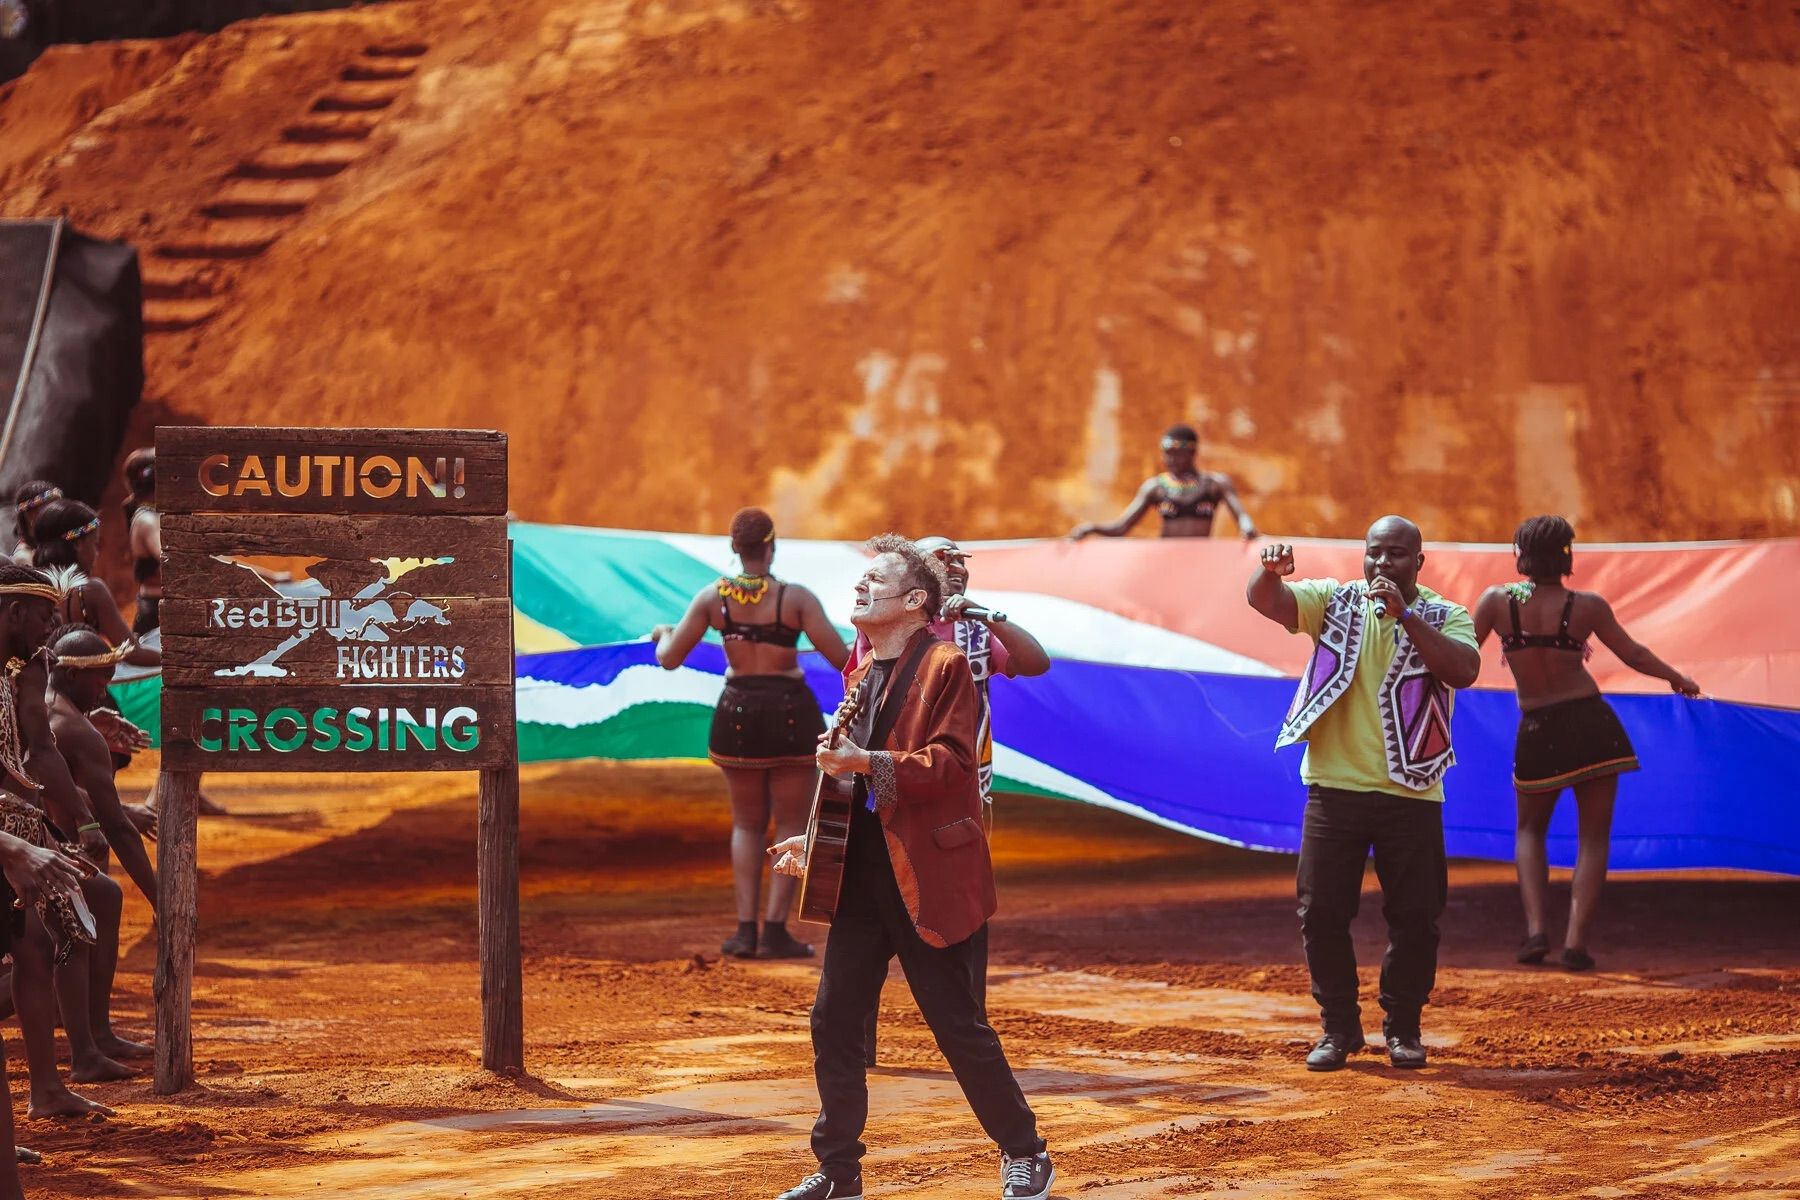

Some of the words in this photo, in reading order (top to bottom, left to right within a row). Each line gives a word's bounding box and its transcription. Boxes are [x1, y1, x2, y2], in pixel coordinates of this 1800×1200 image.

[198, 454, 466, 498] CAUTION!
[208, 599, 269, 628] Red
[276, 599, 337, 628] Bull
[336, 645, 466, 679] FIGHTERS
[194, 706, 480, 752] CROSSING
